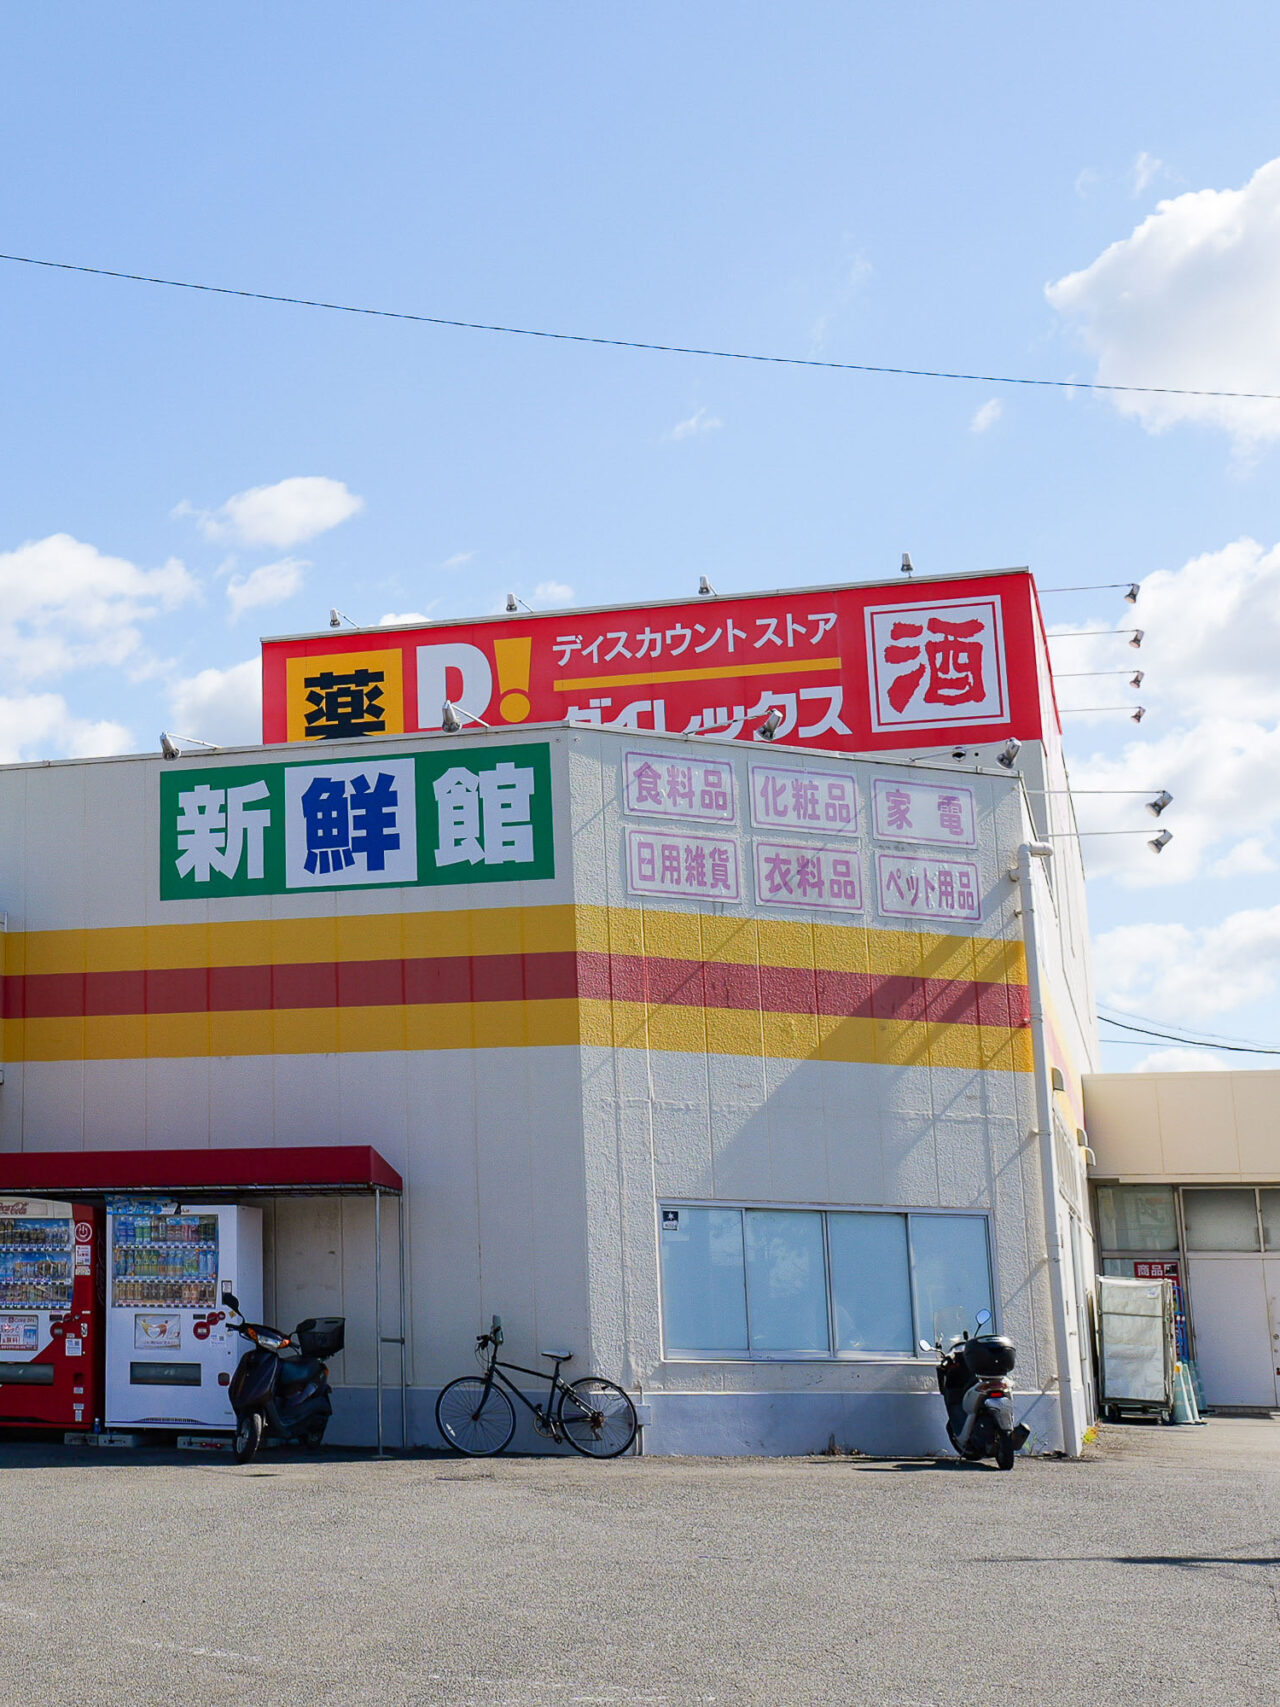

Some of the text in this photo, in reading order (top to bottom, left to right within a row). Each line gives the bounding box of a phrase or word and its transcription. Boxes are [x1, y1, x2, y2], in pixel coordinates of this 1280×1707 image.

[552, 612, 838, 666] ディスカウントストア
[884, 617, 986, 714] 酒
[304, 668, 385, 740] 薬
[632, 761, 728, 811] 食料品
[760, 775, 851, 824] 化粧品
[175, 762, 535, 883] 新鮮館
[885, 788, 964, 836] 家電
[637, 841, 731, 891] 日用雑貨
[763, 852, 856, 900] 衣料品
[886, 867, 975, 911] ペット用品
